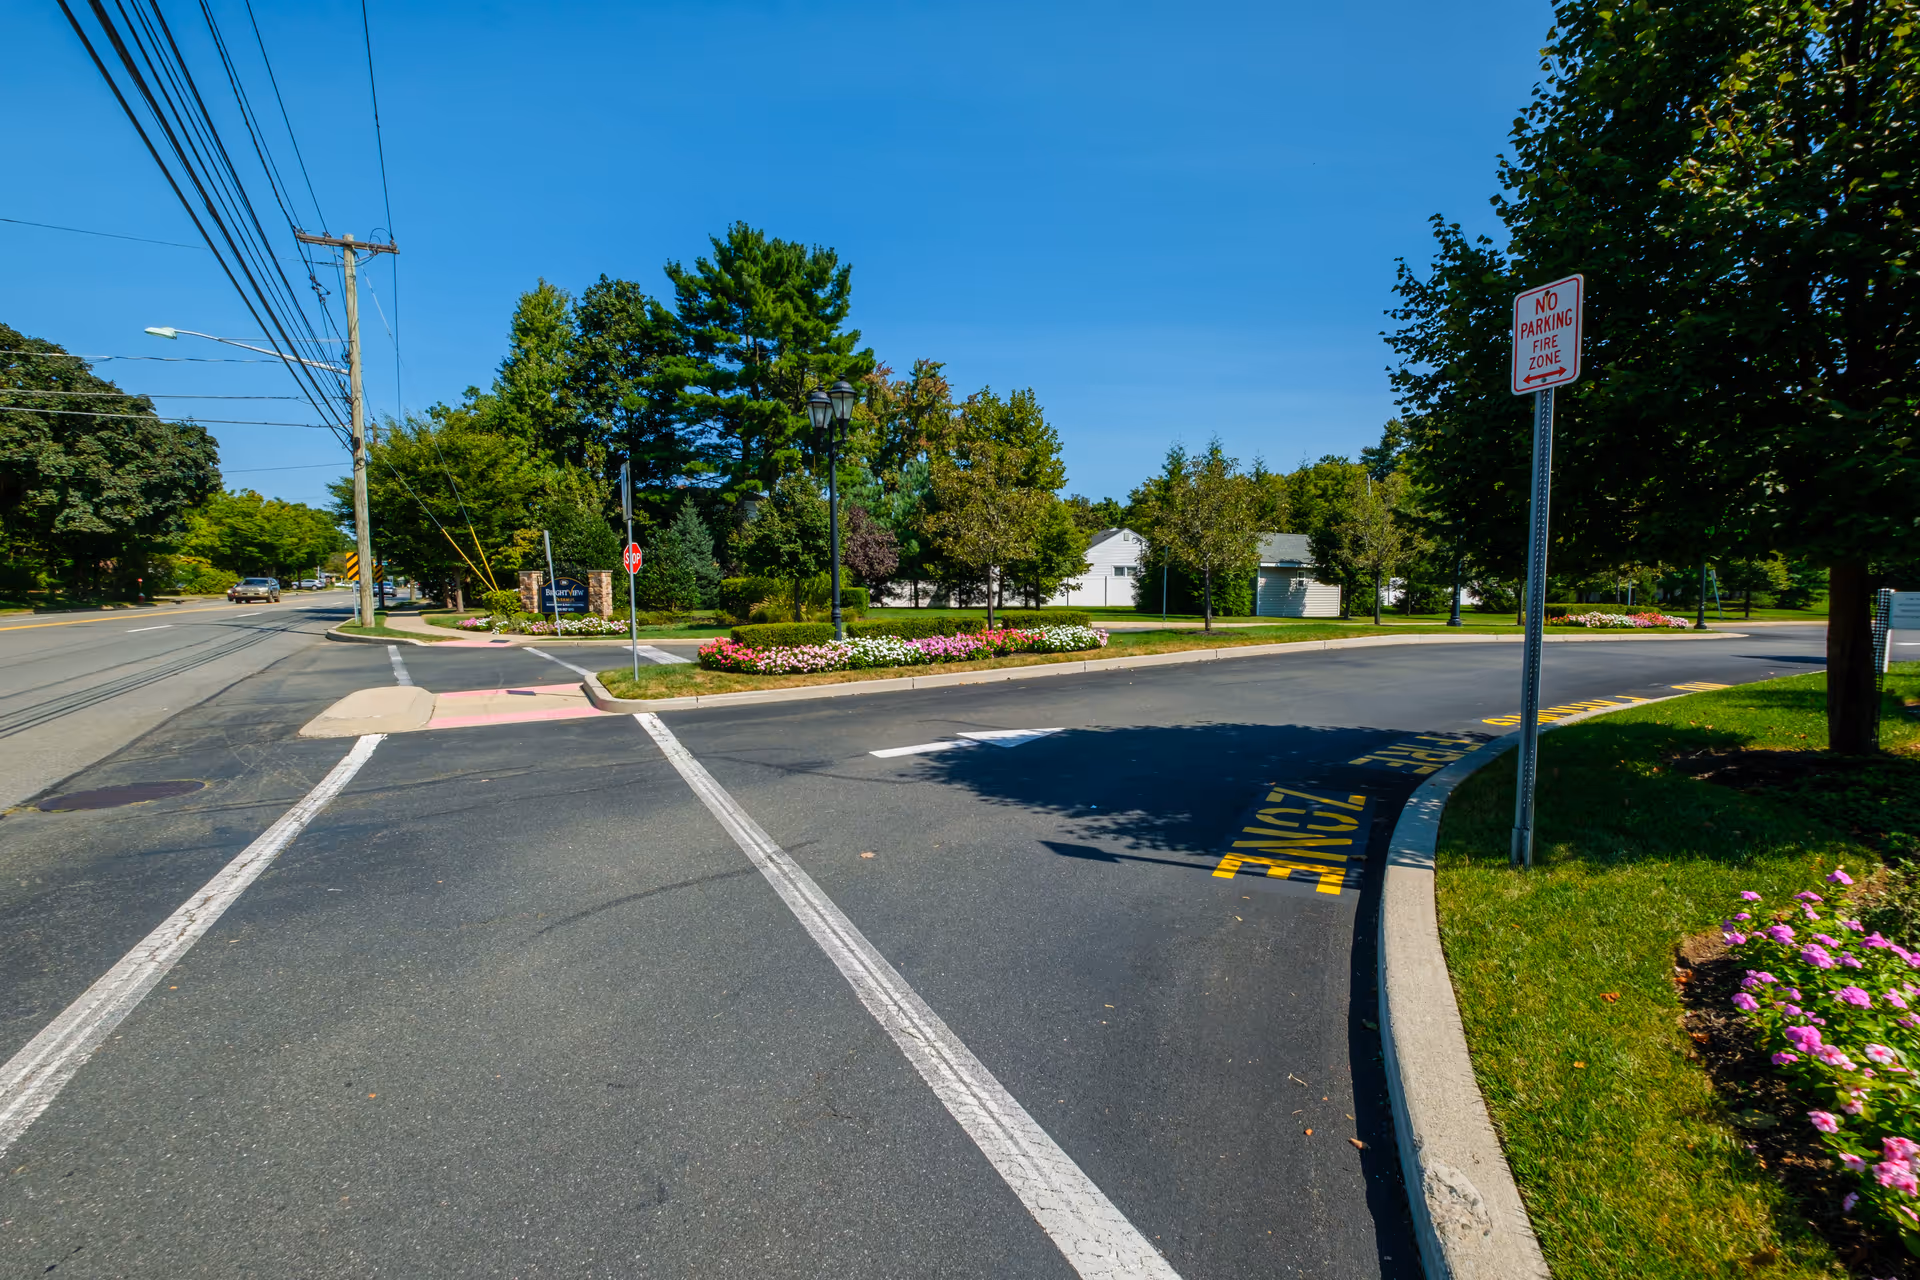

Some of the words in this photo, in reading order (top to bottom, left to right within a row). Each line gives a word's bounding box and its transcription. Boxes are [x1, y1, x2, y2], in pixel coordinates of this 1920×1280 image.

[1535, 292, 1558, 316] NO
[1520, 308, 1573, 340] PARKING
[1532, 334, 1559, 354] FIRE
[1528, 349, 1562, 371] ZONE
[625, 552, 641, 565] SOP
[545, 586, 584, 596] BRGHTVIEW
[1347, 735, 1486, 775] FIRE
[1211, 786, 1367, 895] ZONE
